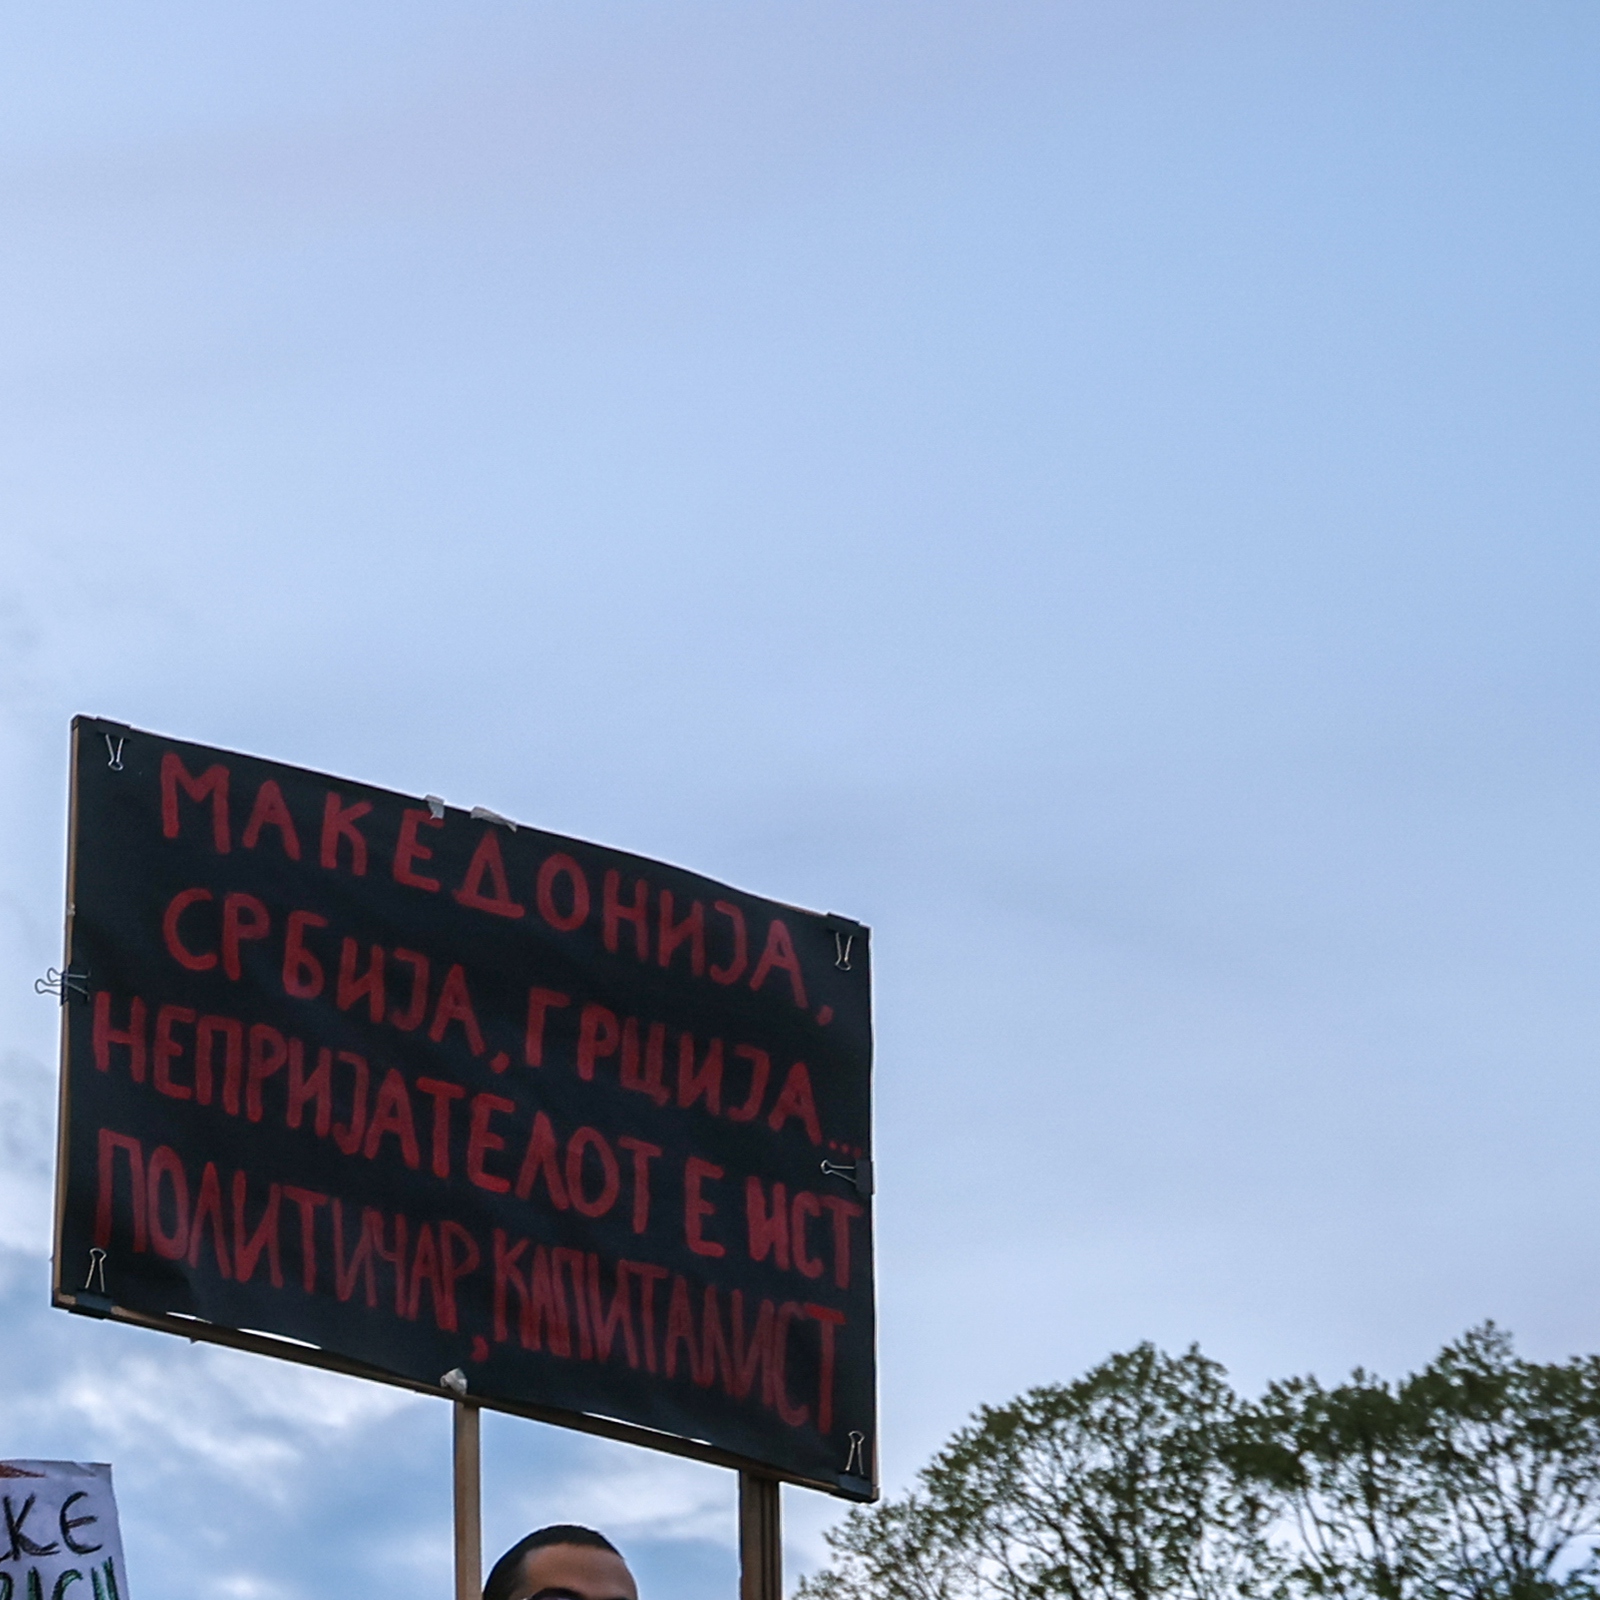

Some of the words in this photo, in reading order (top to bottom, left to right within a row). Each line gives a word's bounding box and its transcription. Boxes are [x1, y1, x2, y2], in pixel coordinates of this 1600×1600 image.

[92, 990, 662, 1236] НЕПРИЈАТЕЛОТ
[683, 1156, 727, 1259] Е
[745, 1177, 864, 1290] ИСТ
[492, 1227, 847, 1436] КАПИТАЛИСТ
